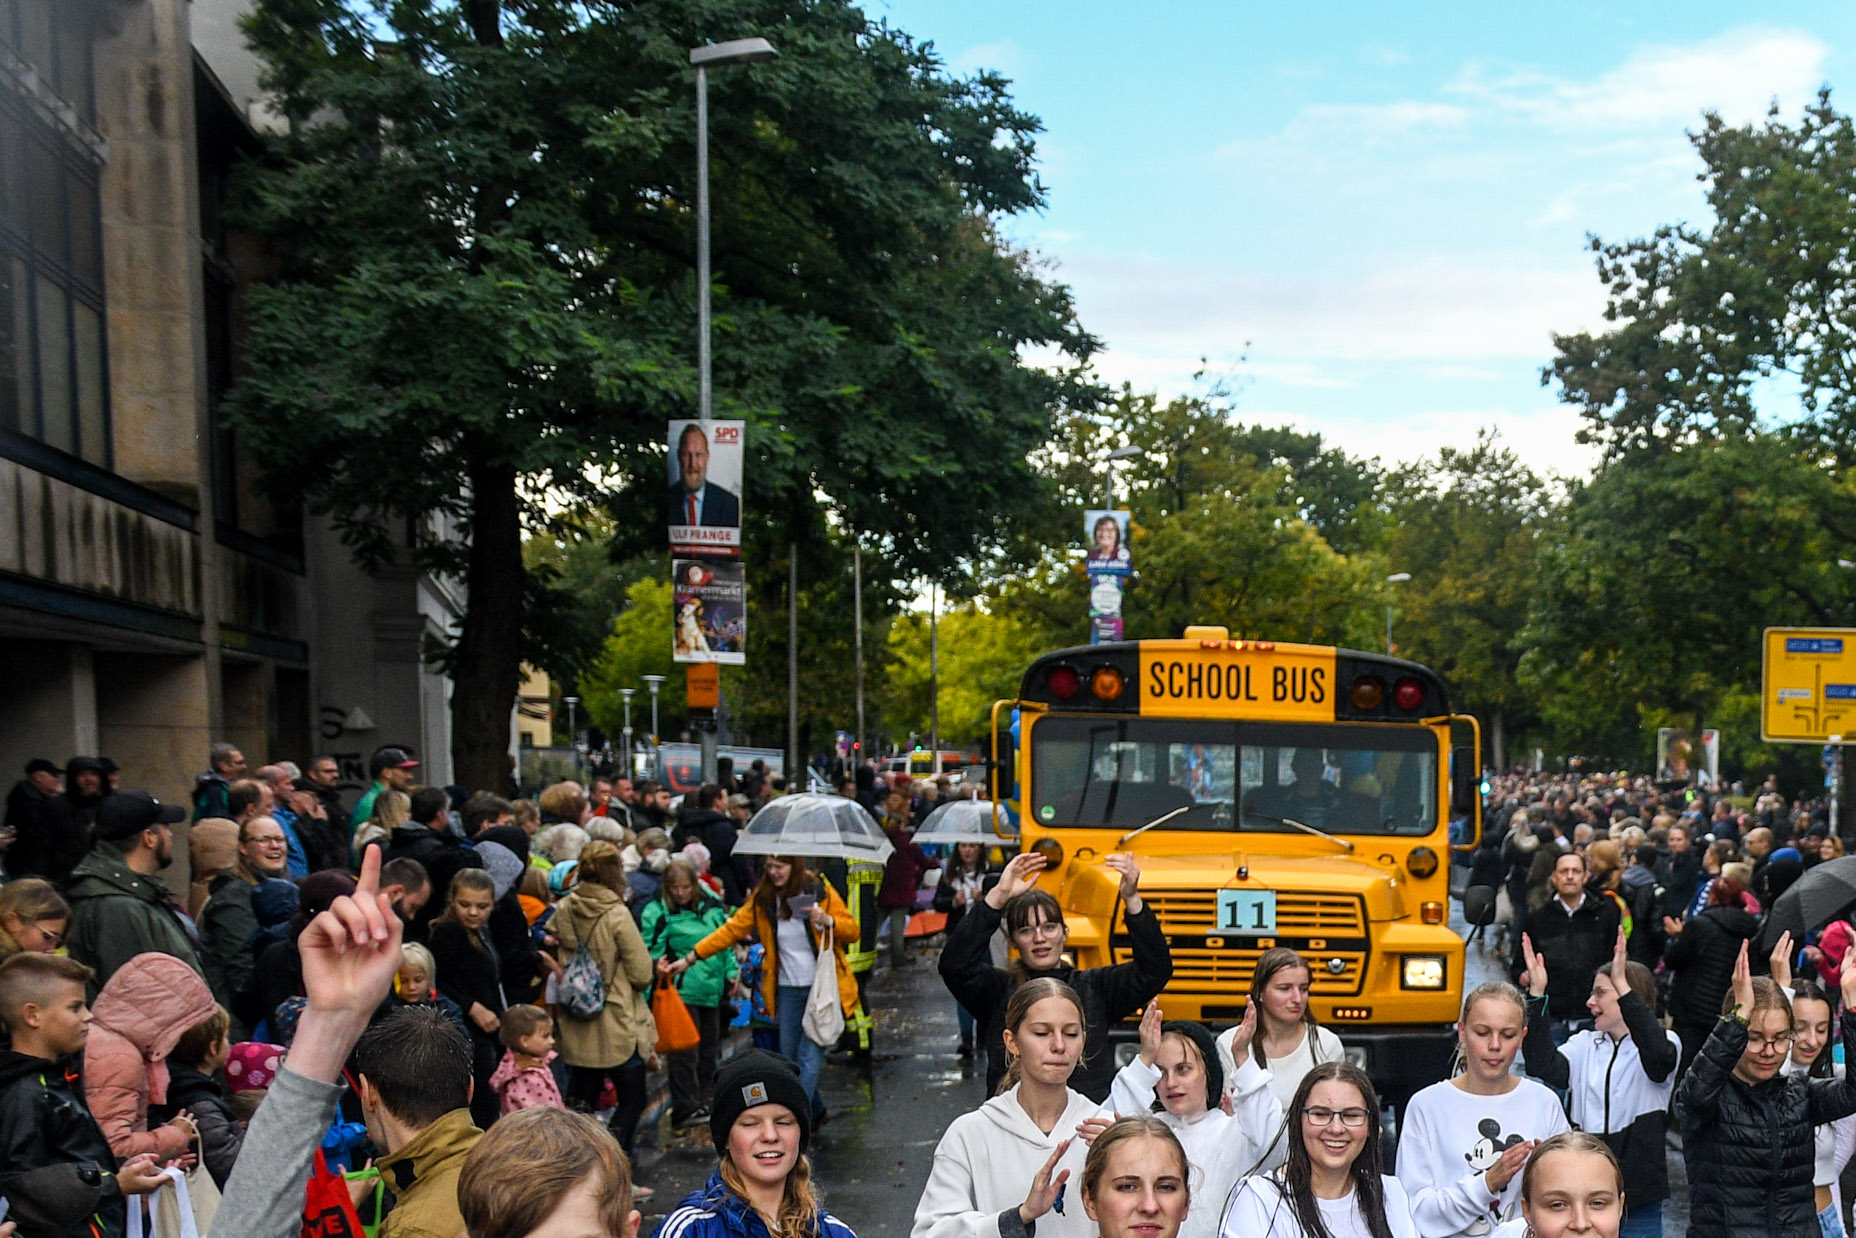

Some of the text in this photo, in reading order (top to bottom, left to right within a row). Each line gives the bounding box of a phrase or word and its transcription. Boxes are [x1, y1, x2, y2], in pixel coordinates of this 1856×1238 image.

[714, 427, 739, 439] SPD
[690, 529, 732, 541] PRANGE
[1150, 661, 1325, 704] SCHOOL BUS
[1225, 900, 1268, 929] 11
